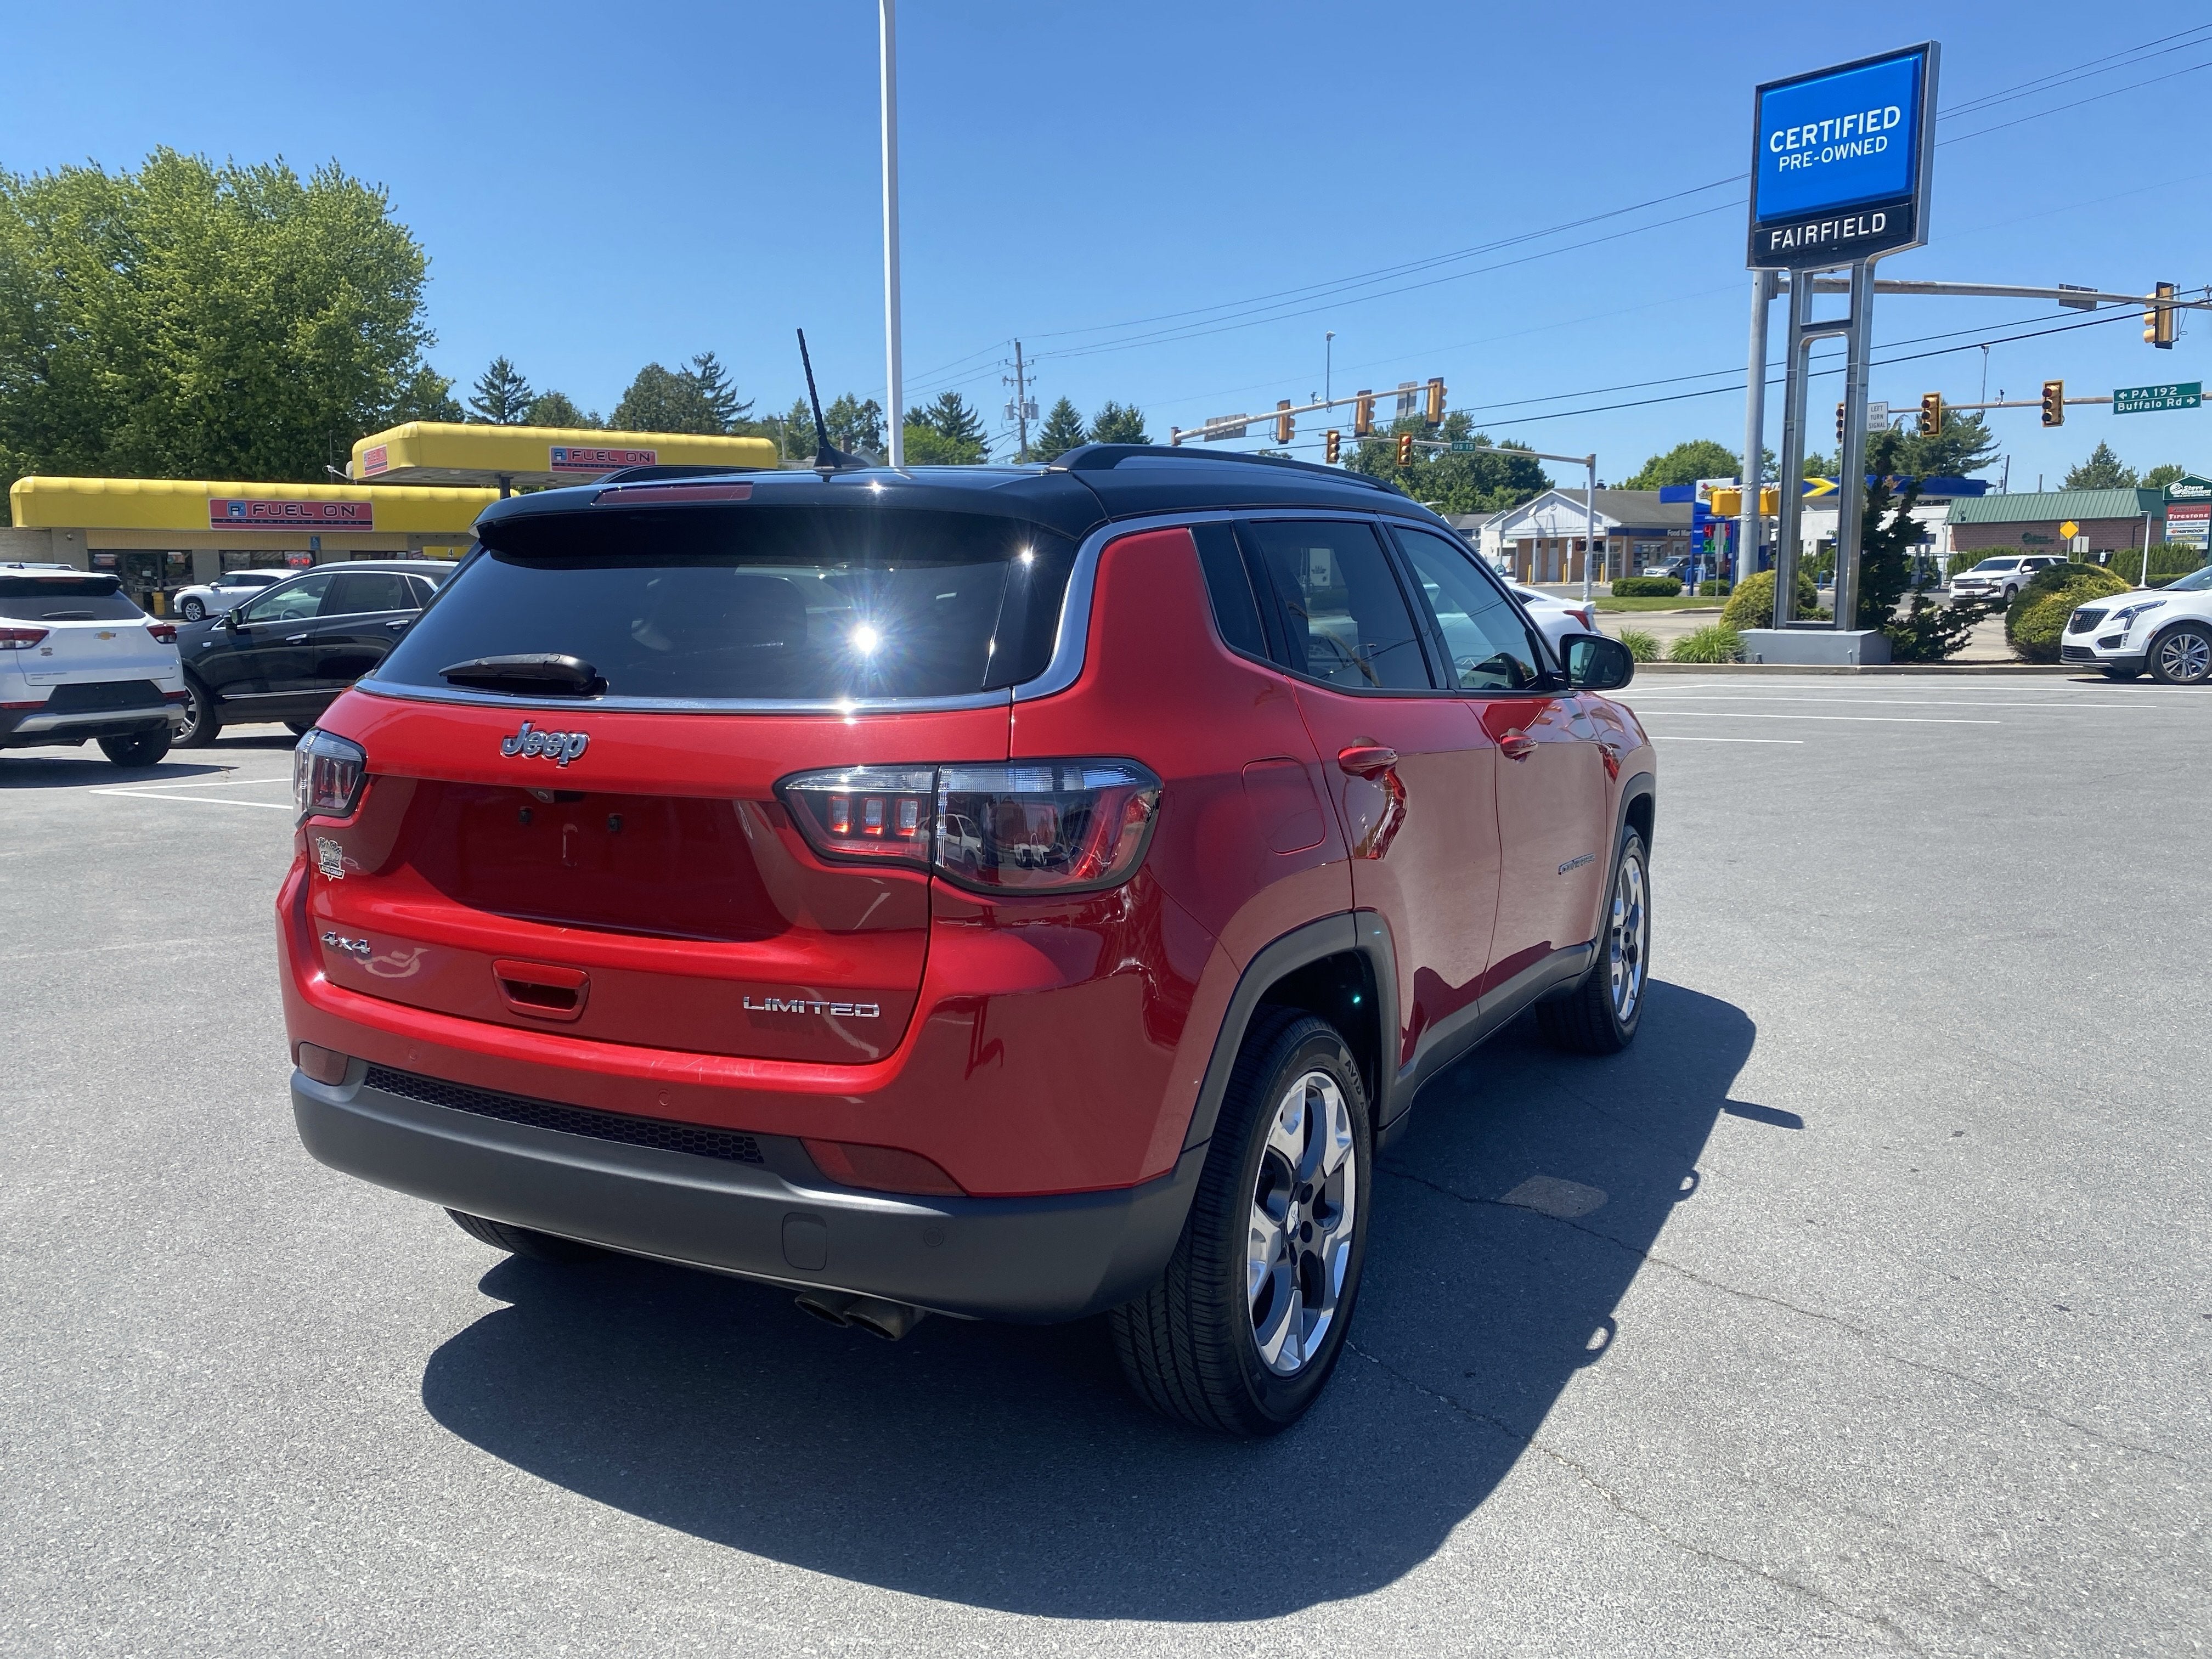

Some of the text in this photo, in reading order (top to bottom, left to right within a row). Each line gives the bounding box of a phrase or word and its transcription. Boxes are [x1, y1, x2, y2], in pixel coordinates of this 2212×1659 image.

[1770, 106, 1901, 153] CERTIFIED
[1779, 136, 1888, 172] PRE-OWNED
[1771, 213, 1887, 250] FAIRFIELD
[2132, 387, 2177, 399] PA 192
[2118, 398, 2182, 411] Buffalo Rd
[572, 450, 650, 462] FUEL ON
[252, 504, 356, 517] FUEL ON
[501, 720, 589, 769] Jeep
[321, 932, 370, 954] 4x4
[743, 996, 879, 1018] LIMITED
[1345, 1060, 1362, 1095] AVID
